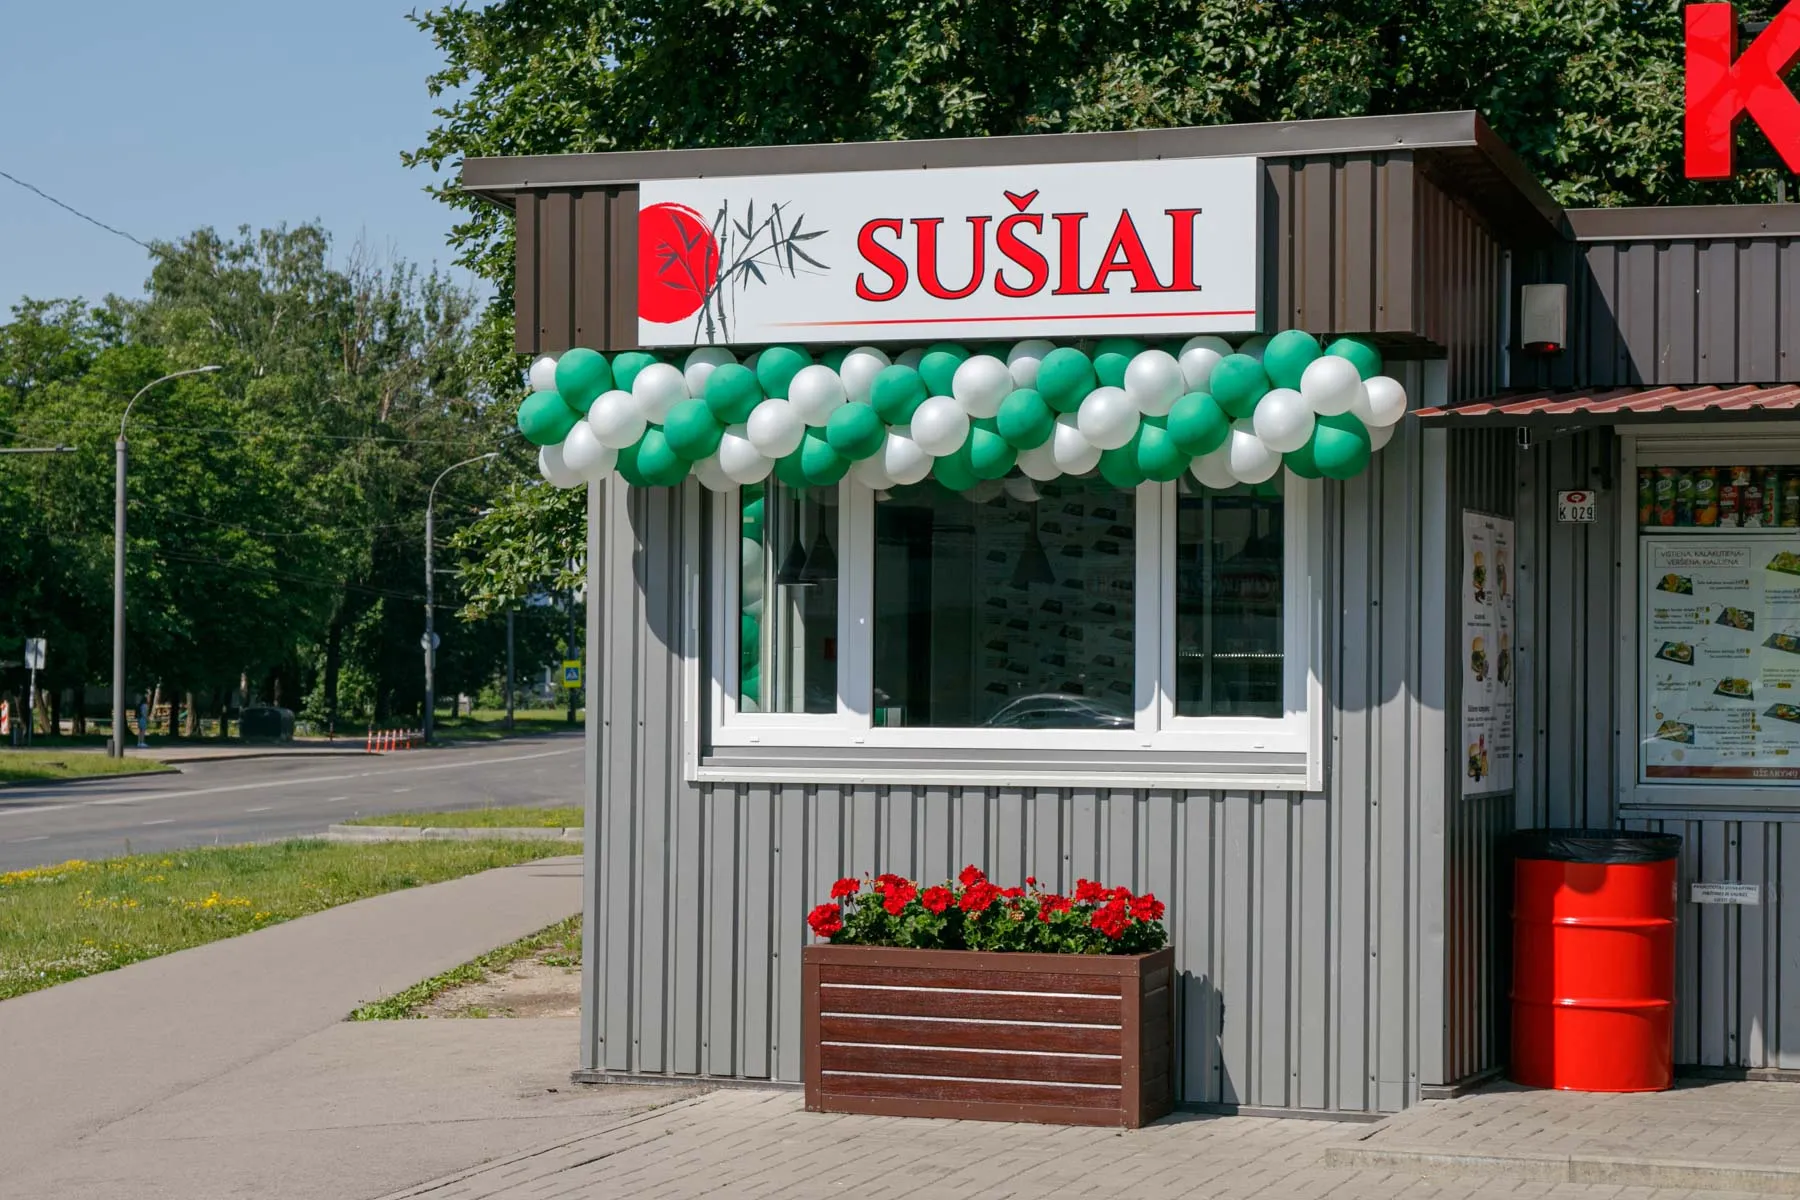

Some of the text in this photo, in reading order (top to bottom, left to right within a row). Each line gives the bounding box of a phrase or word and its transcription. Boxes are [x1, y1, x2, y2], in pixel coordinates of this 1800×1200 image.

[855, 188, 1203, 302] SUŠIAI
[1559, 506, 1593, 519] K 029
